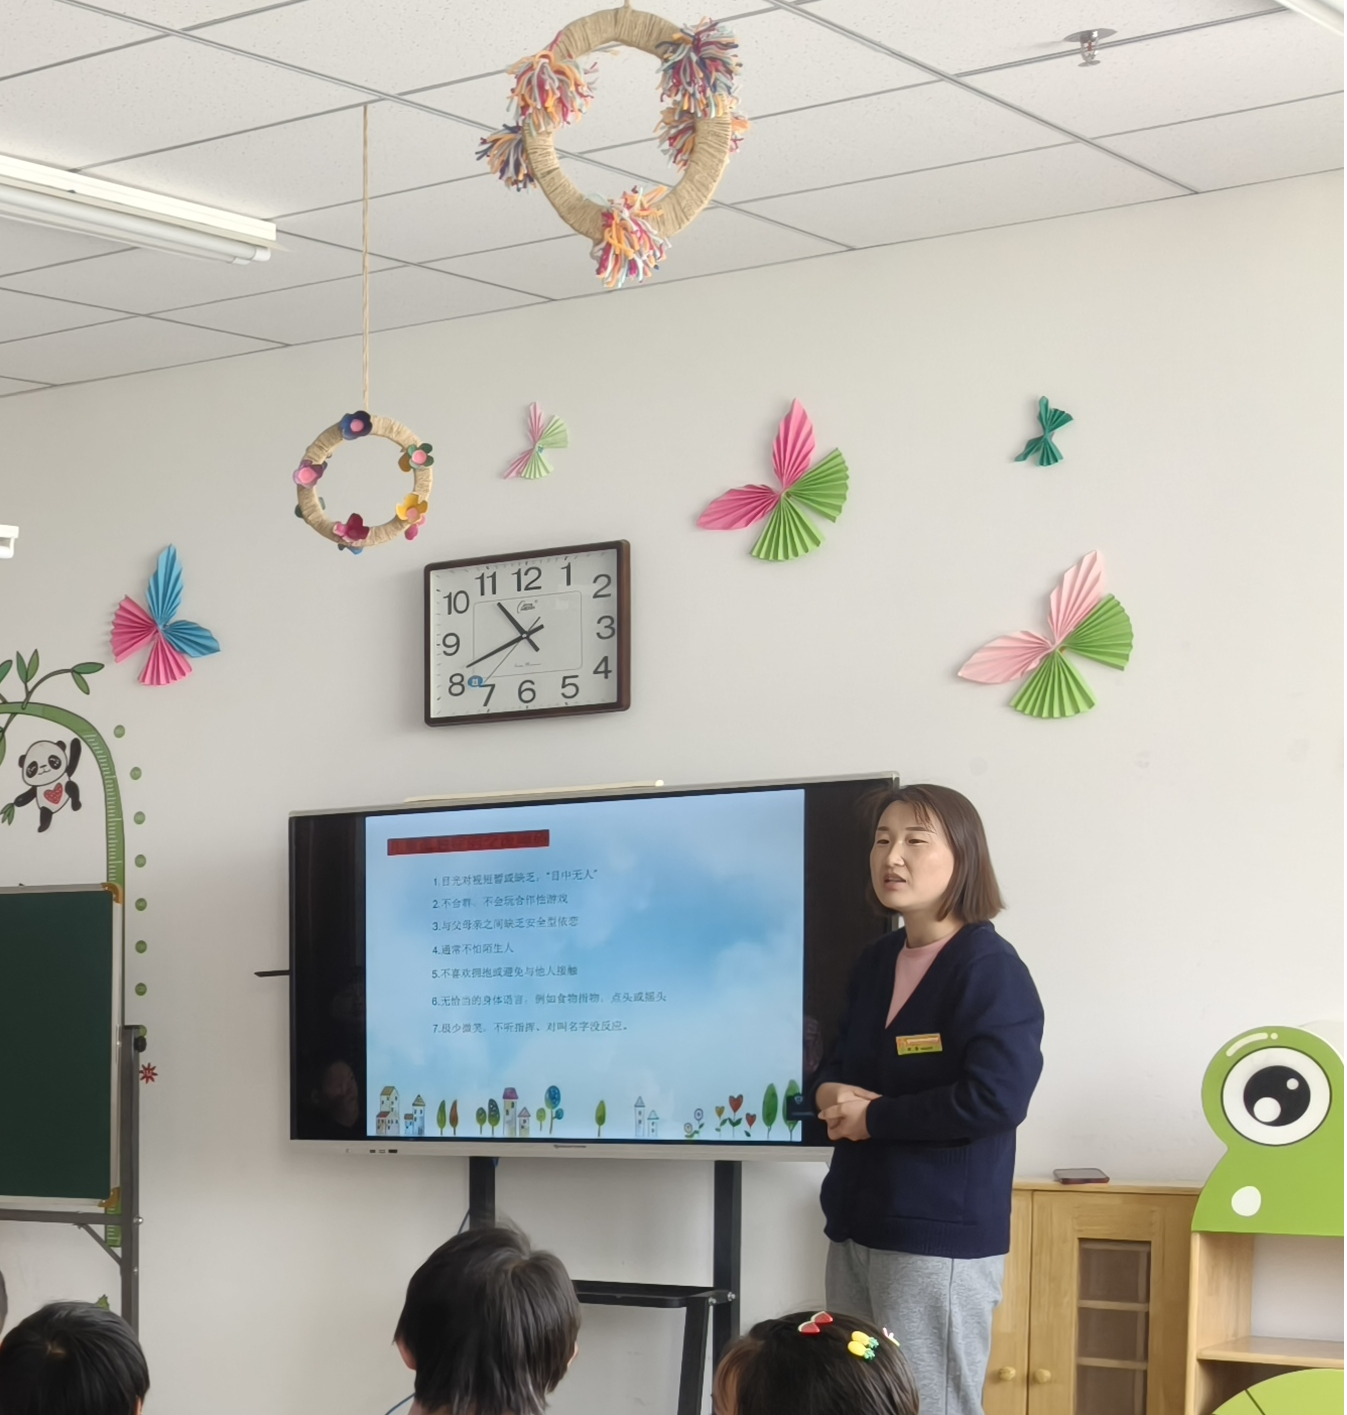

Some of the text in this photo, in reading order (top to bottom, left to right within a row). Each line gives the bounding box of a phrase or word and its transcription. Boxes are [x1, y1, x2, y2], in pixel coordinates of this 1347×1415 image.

[475, 571, 497, 596] 11
[512, 566, 542, 592] 12
[561, 562, 572, 586] 1
[592, 574, 612, 598] 2
[443, 590, 470, 615] 10
[596, 615, 615, 640] 3
[442, 633, 460, 656] 9
[593, 656, 612, 679] 4
[448, 674, 465, 696] 8
[481, 684, 496, 707] 7
[518, 680, 536, 703] 6
[561, 675, 579, 698] 5
